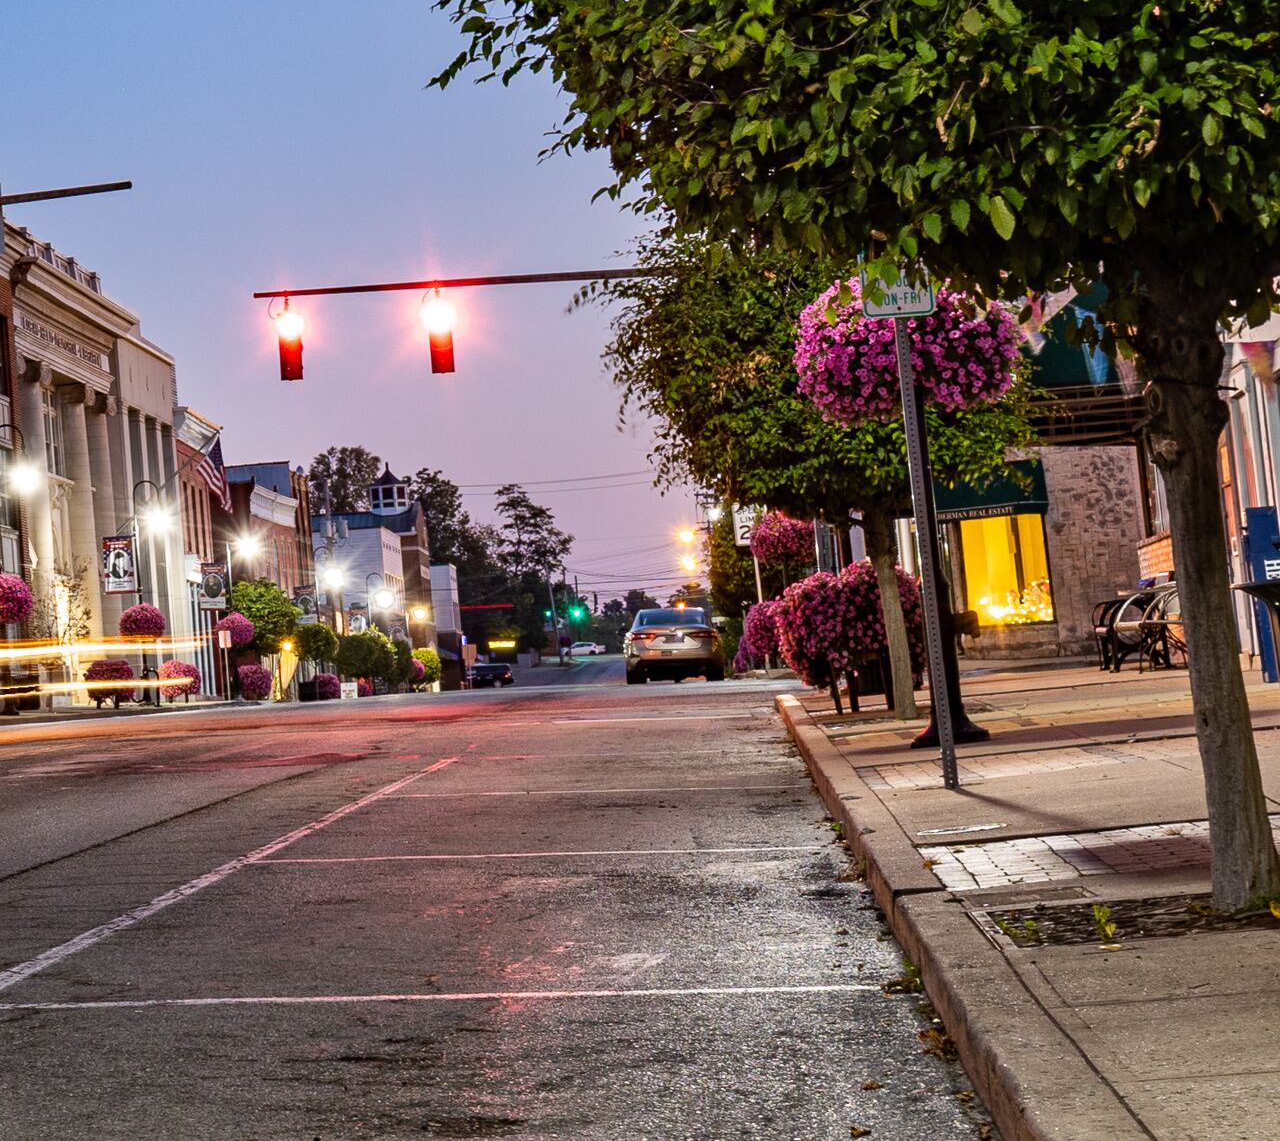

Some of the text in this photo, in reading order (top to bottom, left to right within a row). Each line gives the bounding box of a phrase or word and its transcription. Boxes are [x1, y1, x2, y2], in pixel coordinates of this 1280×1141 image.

[881, 292, 922, 307] ON-FRI
[968, 508, 988, 519] REAL
[989, 506, 1014, 516] ESTATE
[739, 525, 750, 540] 2
